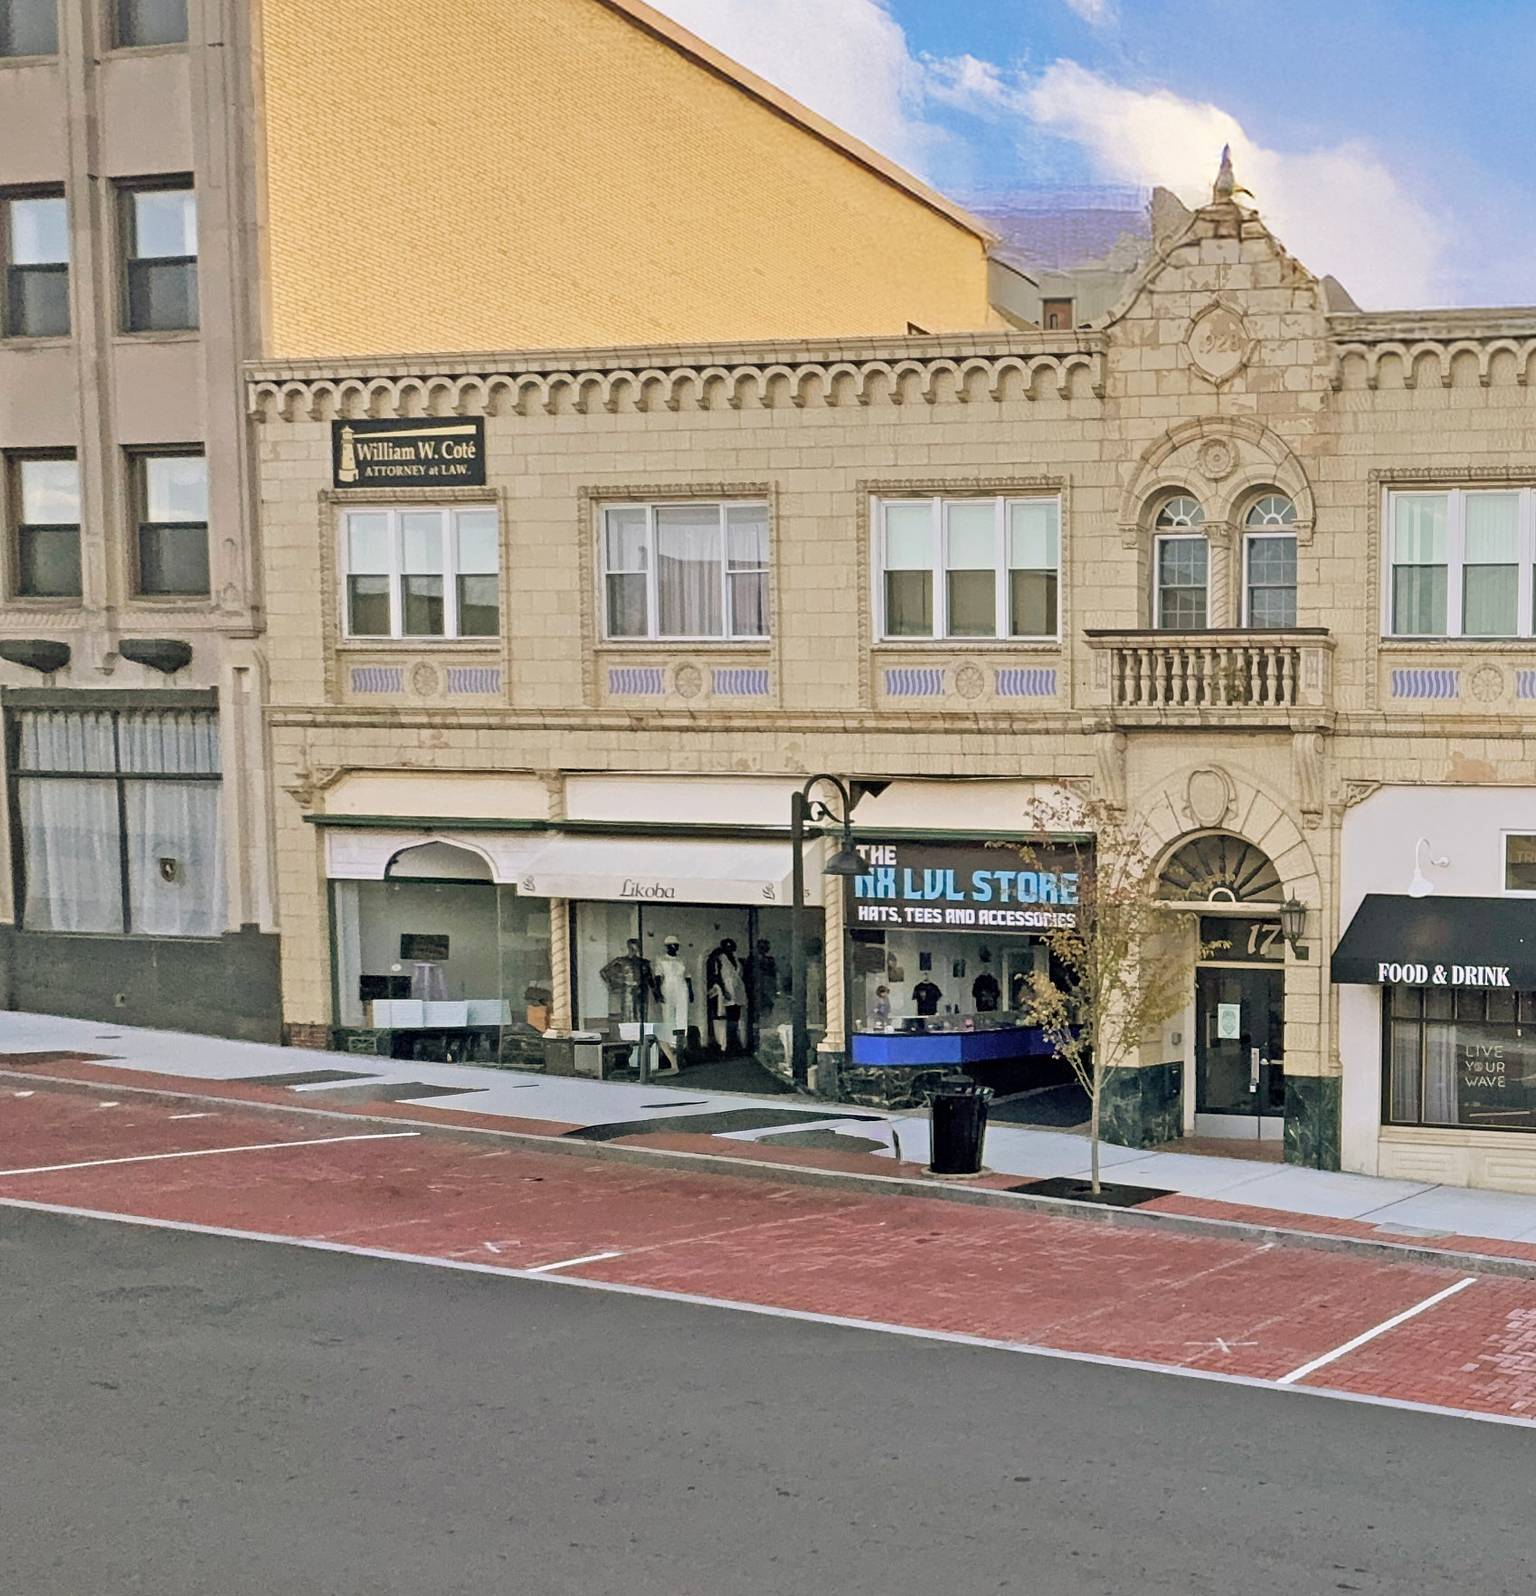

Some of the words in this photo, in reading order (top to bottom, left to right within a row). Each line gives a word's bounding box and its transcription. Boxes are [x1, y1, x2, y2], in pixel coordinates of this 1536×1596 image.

[357, 443, 415, 460] William
[417, 441, 438, 459] W.
[442, 441, 476, 459] Coté
[365, 465, 425, 477] ATTORNEY
[429, 465, 438, 475] at
[441, 464, 466, 475] LAW
[855, 845, 897, 865] THE
[619, 879, 675, 899] Likoba
[972, 870, 1079, 904] STORE
[858, 905, 902, 923] HATS,
[904, 907, 942, 923] TEES
[946, 908, 973, 924] AND
[979, 909, 1076, 929] ACCESSORIES
[1378, 962, 1429, 984] FOOD
[1432, 964, 1448, 985] &
[1452, 965, 1511, 987] DRINK
[1465, 1044, 1504, 1059] LIVE
[1465, 1075, 1507, 1088] WAVE
